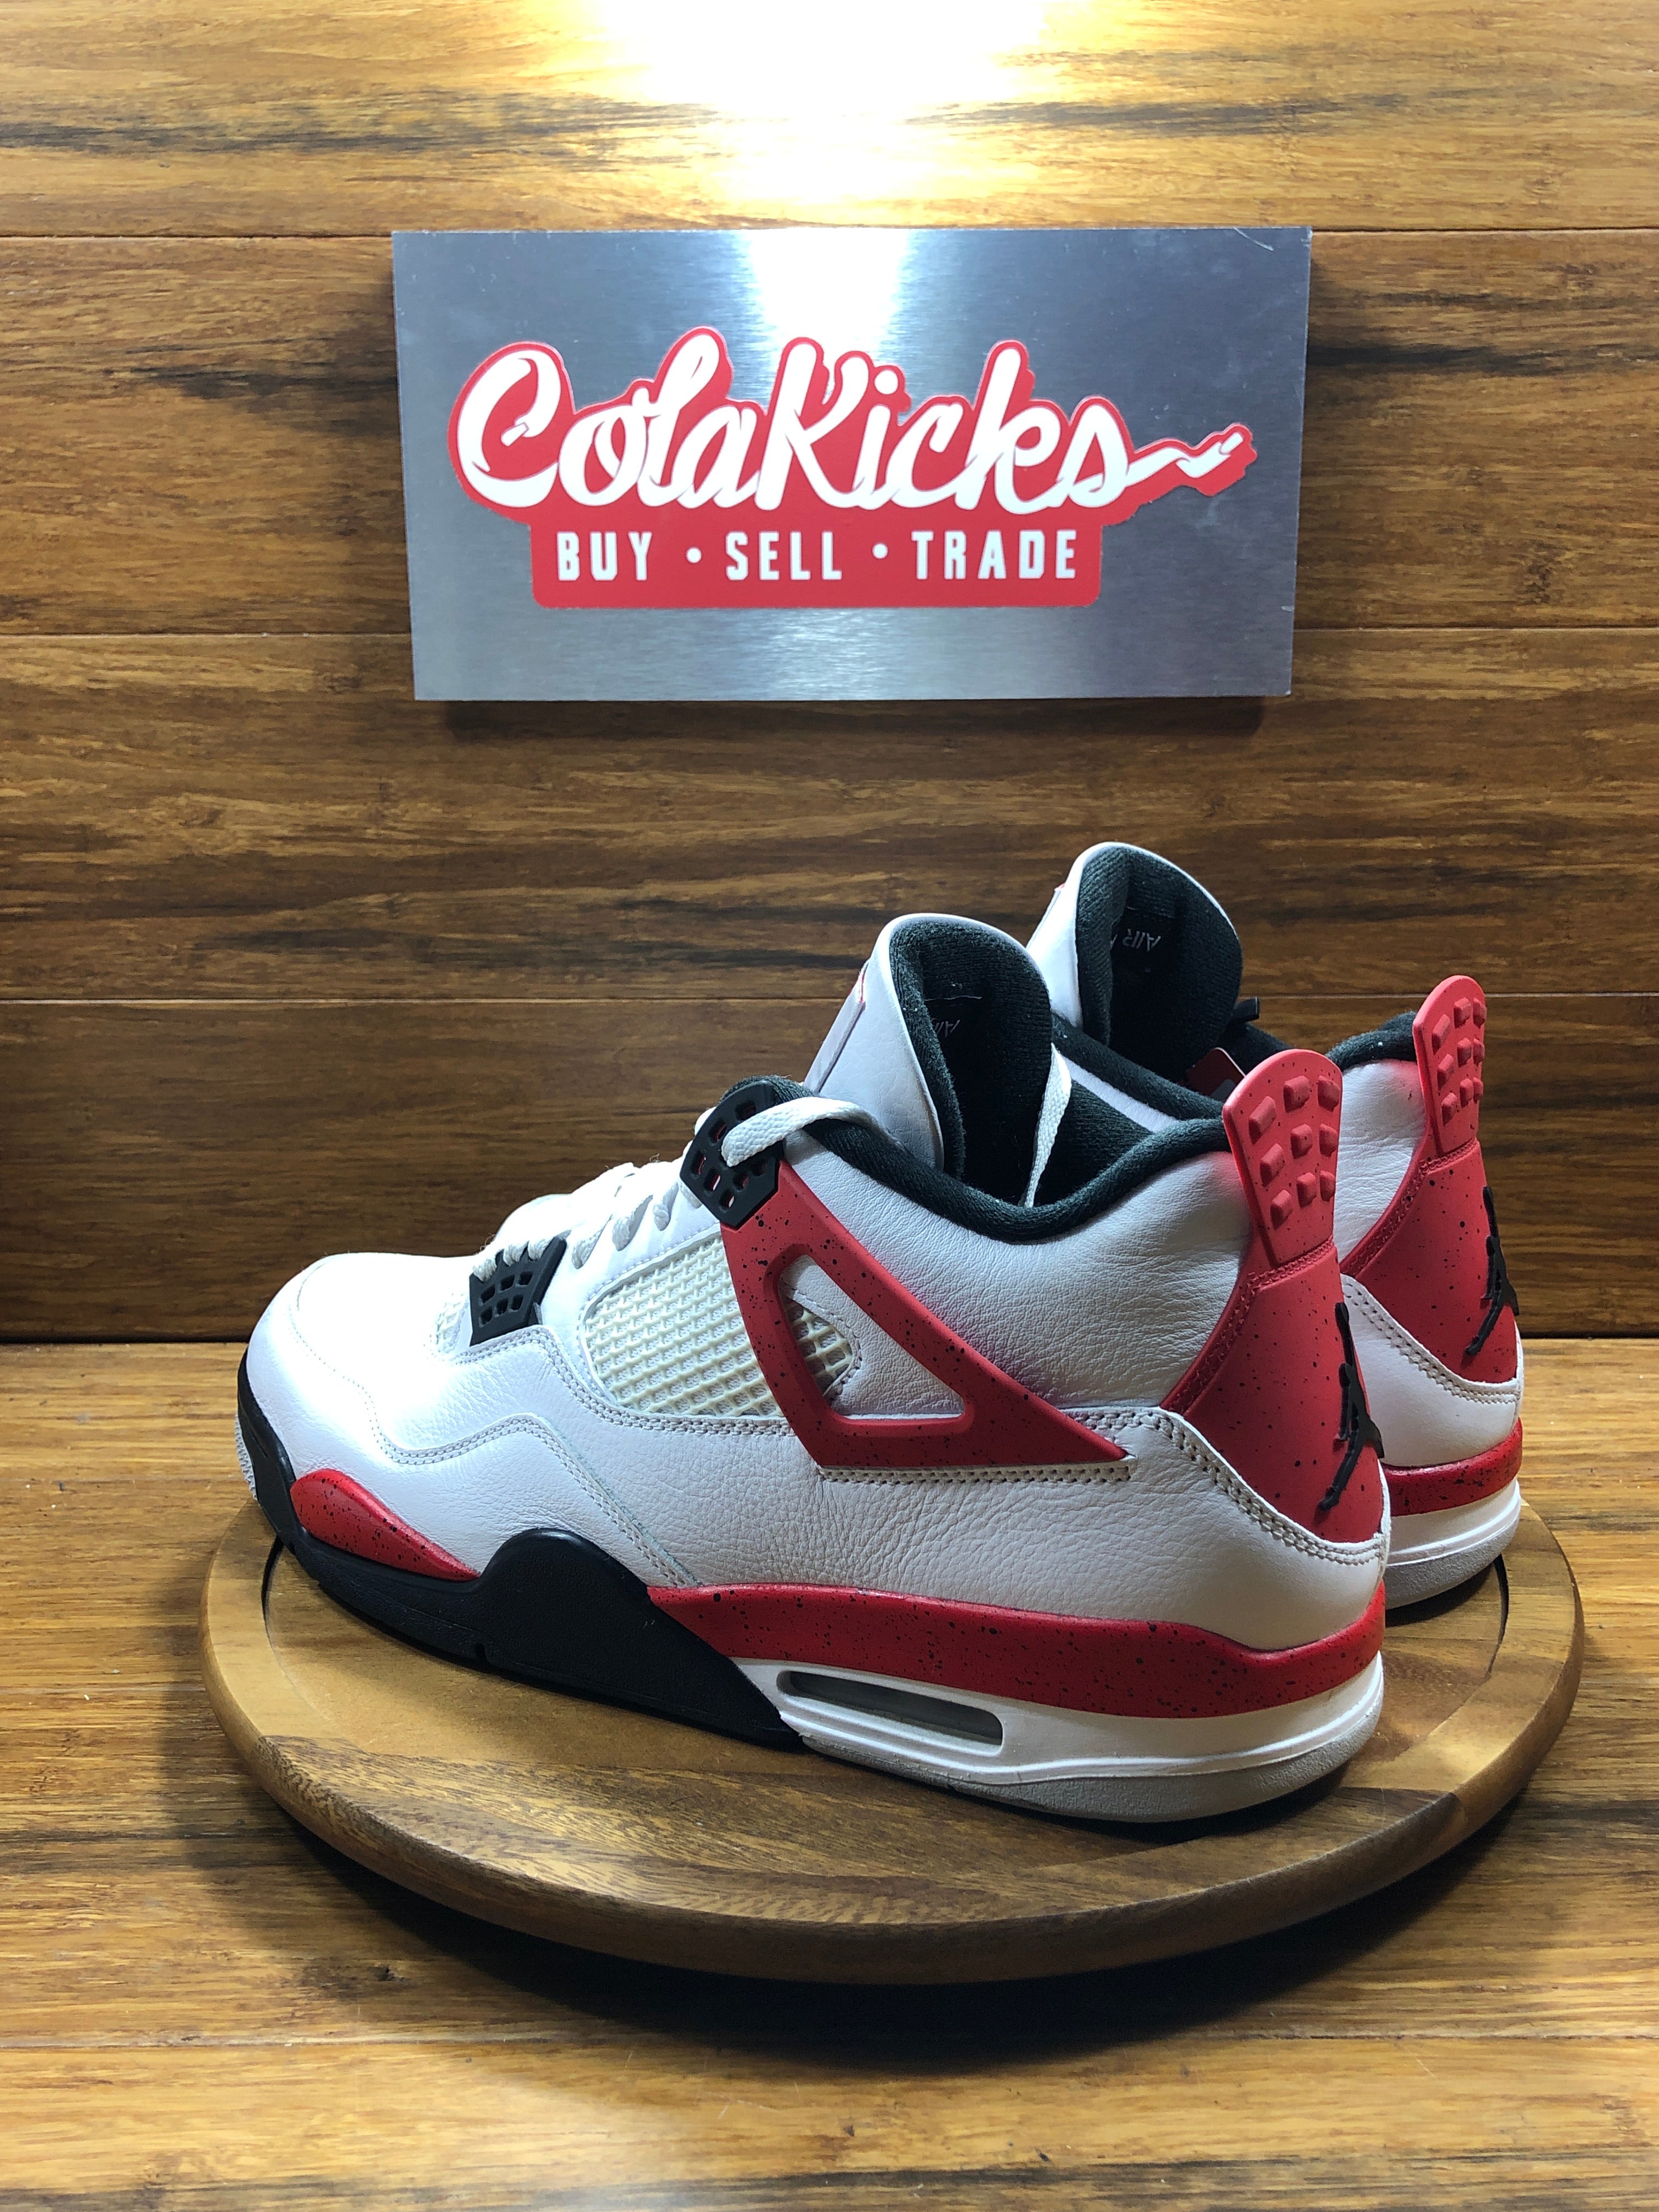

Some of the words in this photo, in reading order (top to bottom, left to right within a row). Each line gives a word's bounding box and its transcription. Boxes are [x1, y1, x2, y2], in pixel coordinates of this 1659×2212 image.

[456, 332, 1244, 515] ColaKicks
[557, 531, 653, 581] BUY
[726, 531, 843, 580] SELL
[911, 529, 1077, 580] TRADE
[1122, 928, 1162, 953] AIR
